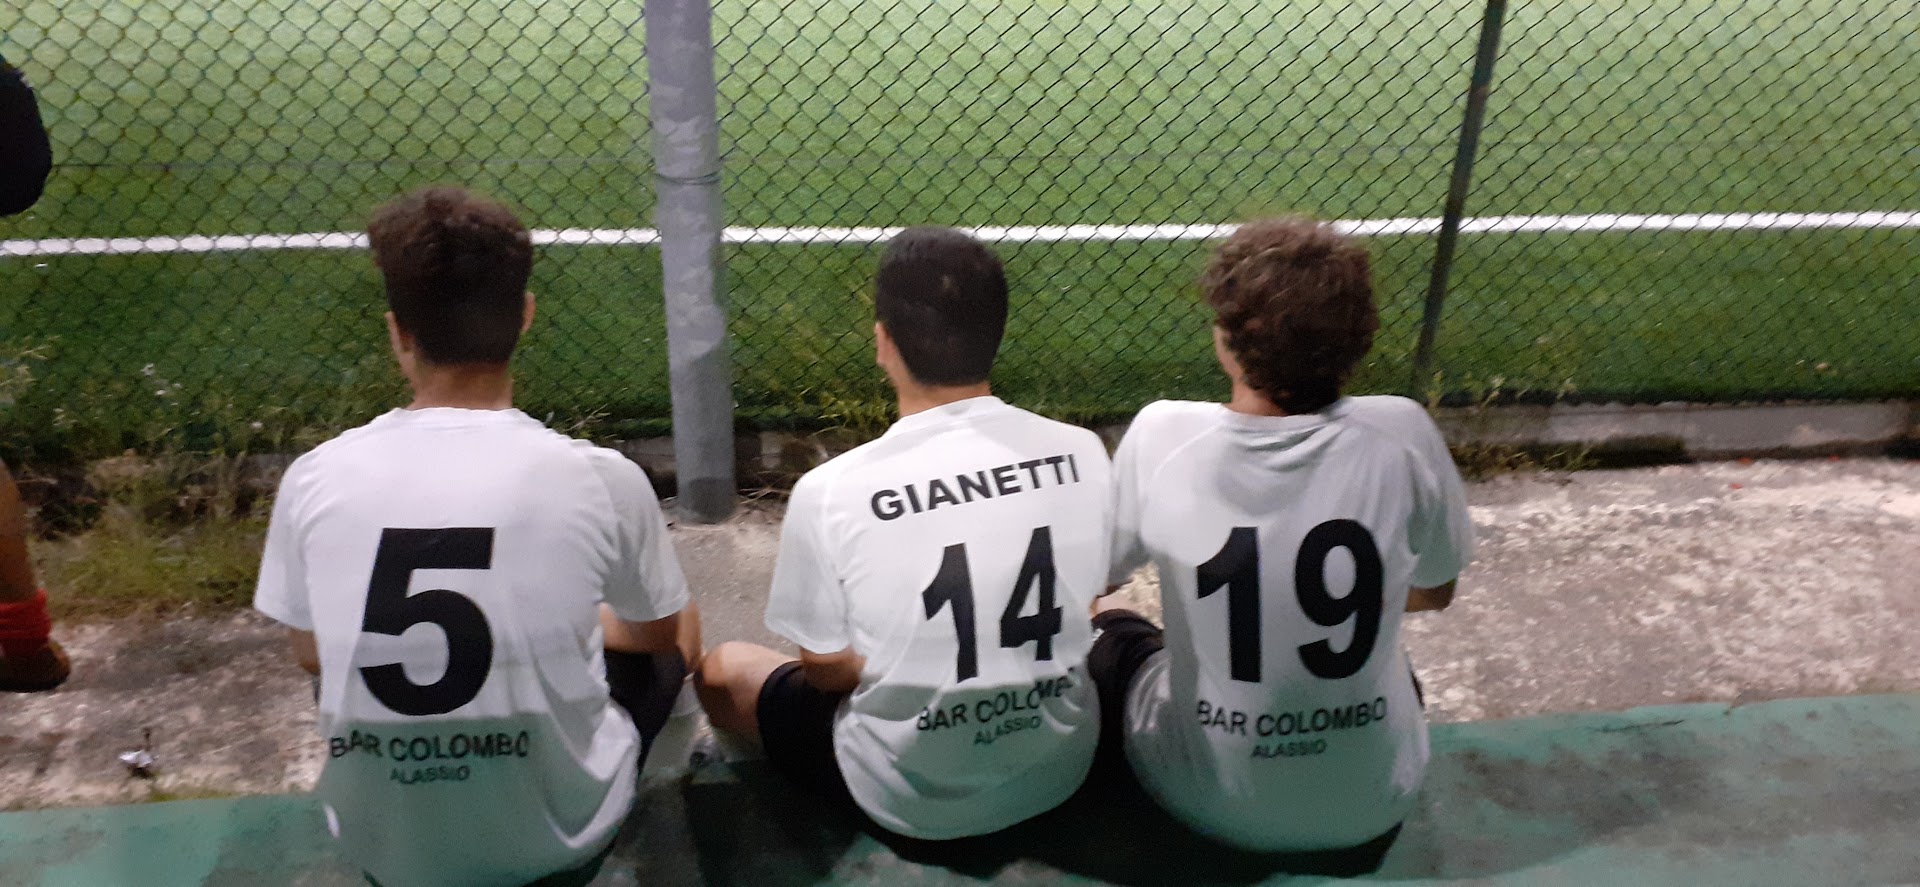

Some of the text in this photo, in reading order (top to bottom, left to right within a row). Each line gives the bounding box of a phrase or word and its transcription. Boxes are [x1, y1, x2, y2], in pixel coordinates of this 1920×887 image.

[870, 453, 1080, 521] GIANETTI
[358, 526, 495, 716] 5
[922, 525, 1064, 684] 14
[1196, 518, 1384, 683] 19
[330, 730, 530, 762] BAR COLOMBO
[916, 703, 968, 731] BAR
[1197, 696, 1387, 737] BAR COLOMBO
